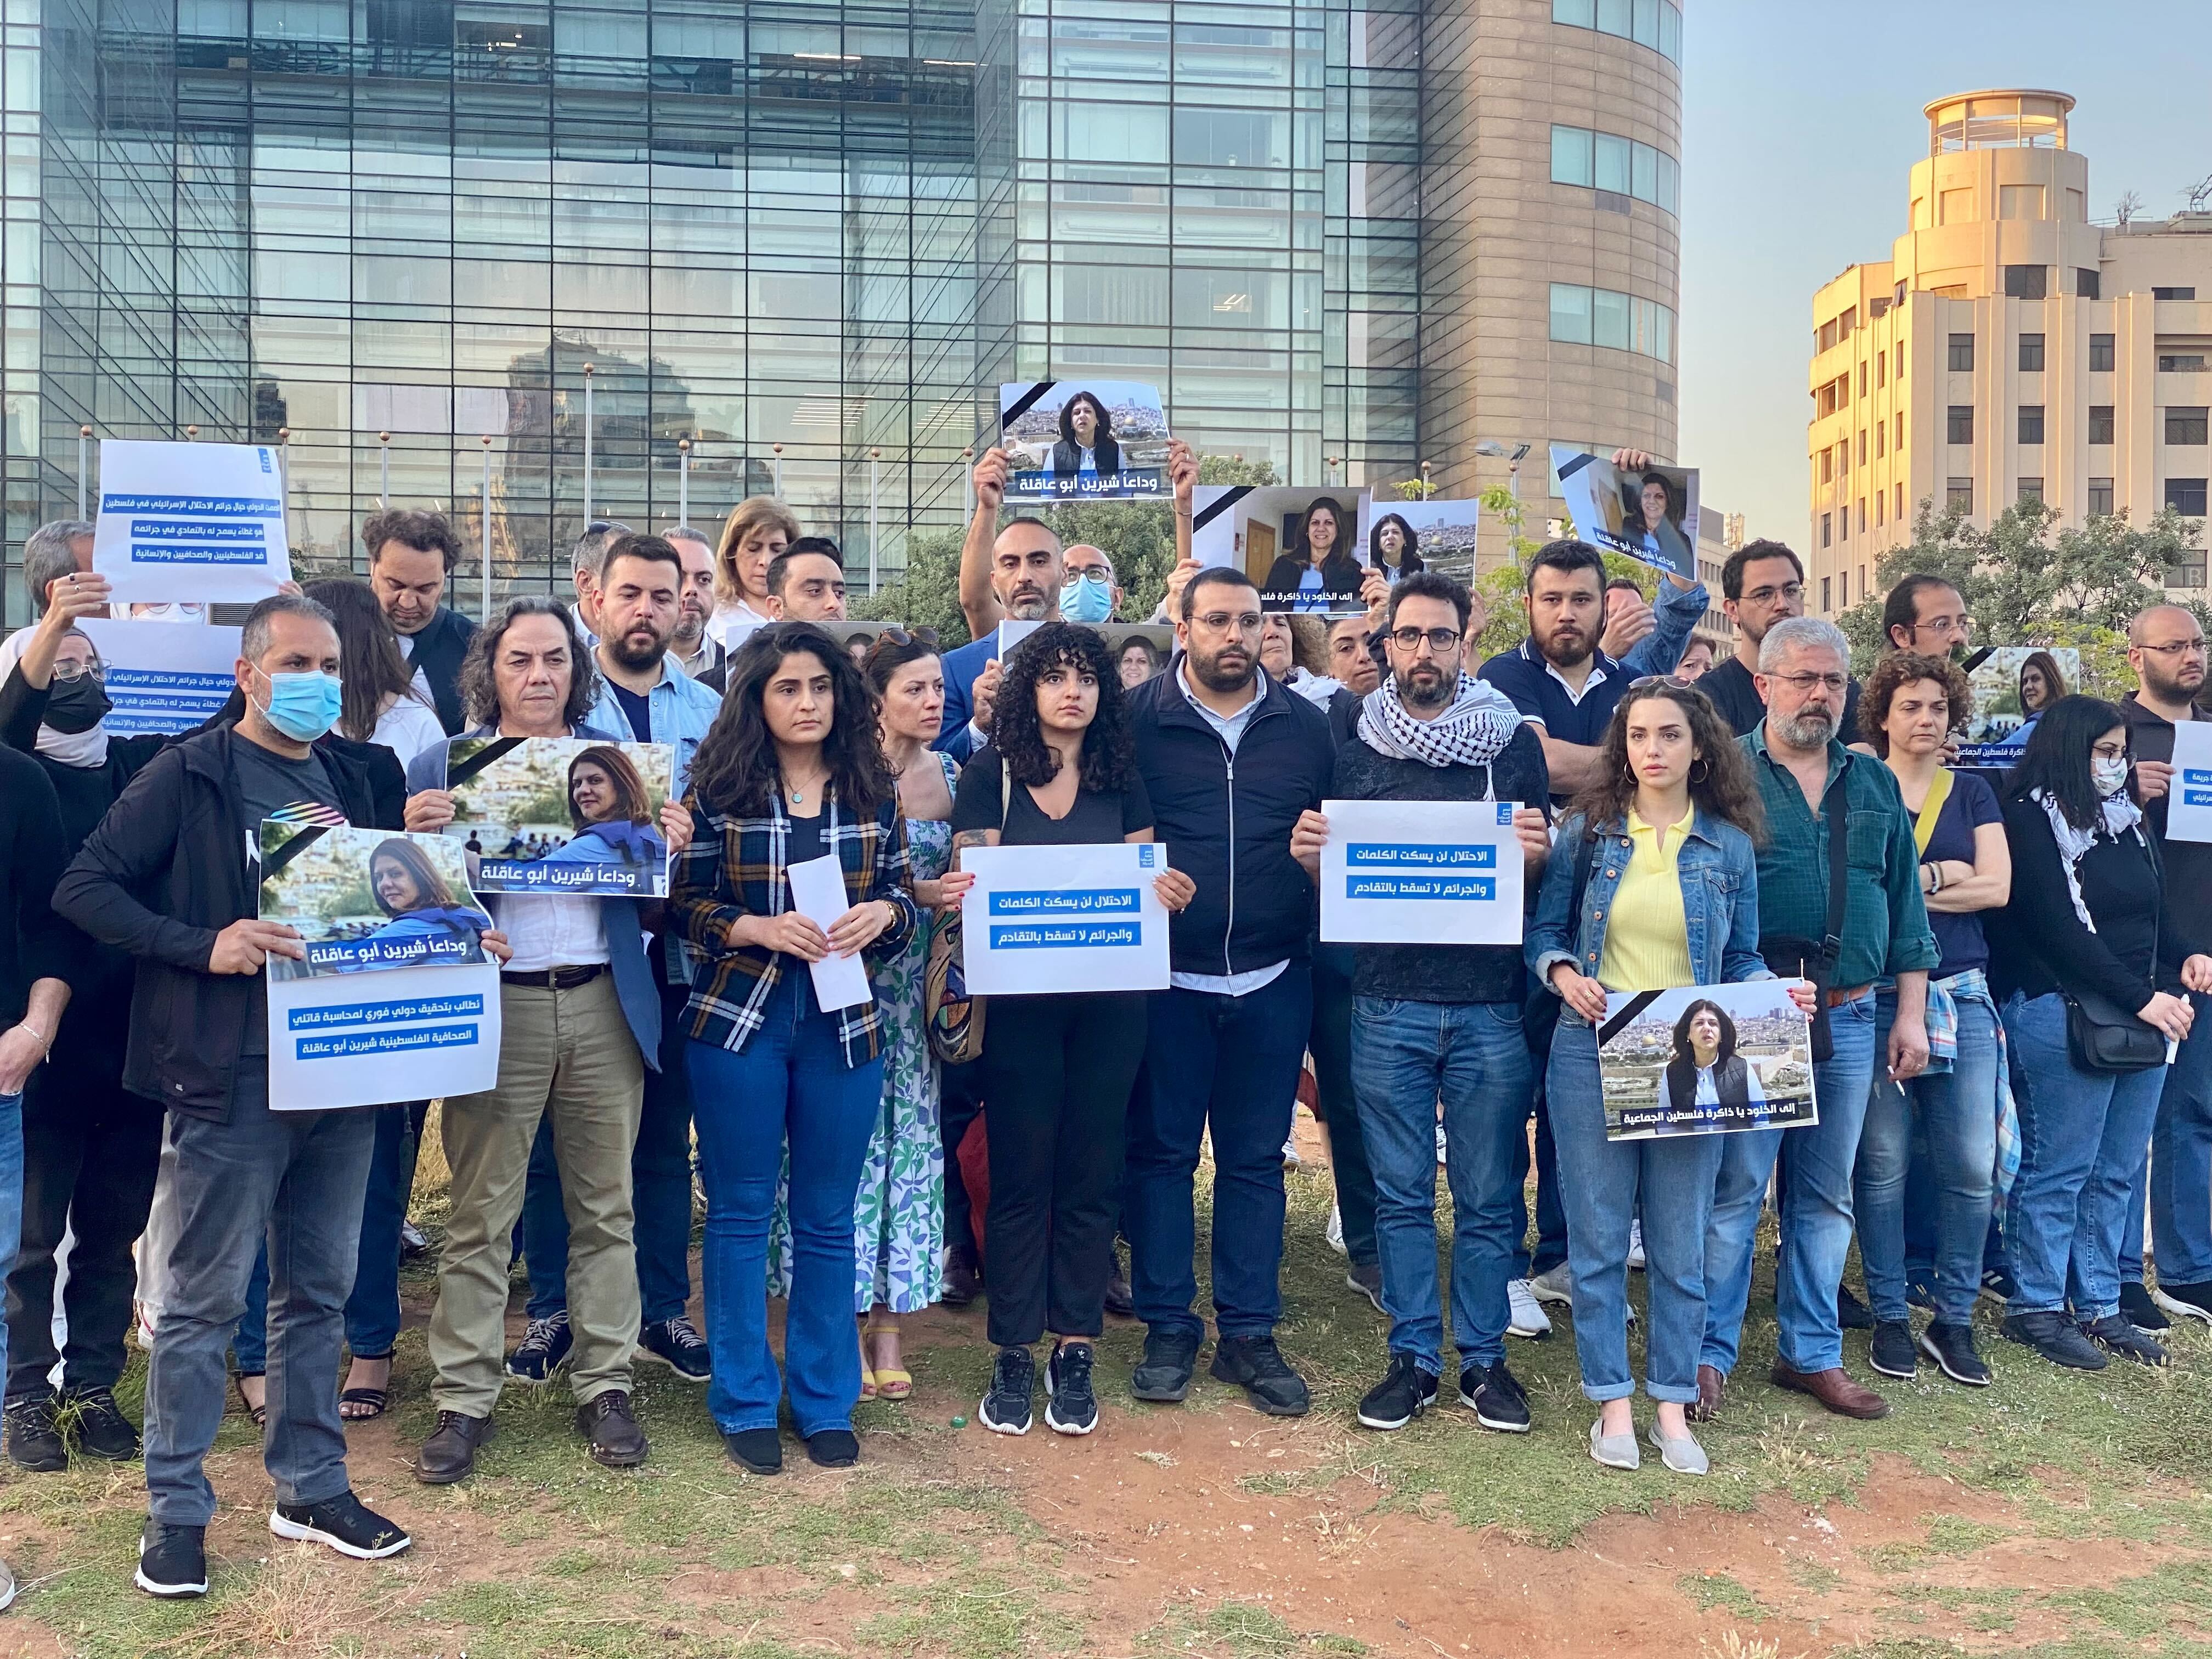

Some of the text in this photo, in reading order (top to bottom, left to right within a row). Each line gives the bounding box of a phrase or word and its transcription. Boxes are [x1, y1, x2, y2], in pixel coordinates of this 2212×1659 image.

[1019, 470, 1157, 493] وداعاً شيرين أبو عاقلة
[105, 499, 134, 509] فلسطين
[136, 500, 149, 509] في
[188, 500, 213, 510] الاحتلال
[215, 501, 232, 512] جرائم
[233, 502, 246, 511] حيال
[246, 502, 264, 513] الدولي
[162, 525, 175, 534] في
[176, 526, 205, 537] بالتمادي
[216, 527, 236, 537] يسمح
[254, 528, 263, 537] هو
[1596, 533, 1618, 546] عاقلة
[1633, 546, 1654, 559] شيرين
[1278, 593, 1301, 603] ذاكرة
[1303, 592, 1310, 601] يا
[1312, 592, 1337, 602] الخلود
[1339, 592, 1352, 602] إلى
[113, 674, 149, 684] الإسرائيلي
[177, 677, 197, 686] جرائم
[139, 698, 167, 707] بالتمادي
[137, 720, 176, 729] والصحافيين
[1983, 748, 2008, 757] فلسطين
[2192, 774, 2209, 782] جريمة
[1357, 850, 1487, 862] الاحتلال لن يسكت الكلمات
[482, 863, 635, 887] وداعاً شيرين أبو عاقلة
[1355, 882, 1486, 897] والجرائم لا تسقط بالتقادم
[999, 895, 1131, 909] الاحتلال لن يسكت الكلمات
[998, 929, 1132, 945] والجرائم لا تسقط بالتقادم
[311, 935, 466, 963] وداعاً شيرين أبو عاقلة
[292, 1000, 479, 1026] نطالب بتحقيق دولي فوري لمحاسبة قاتلي
[302, 1030, 471, 1053] الصحافية الفلسطينية شيرين أبو عاقلة
[1624, 1103, 1795, 1124] إلى الخلود يا ذاكرة فلسطين الجماعية
